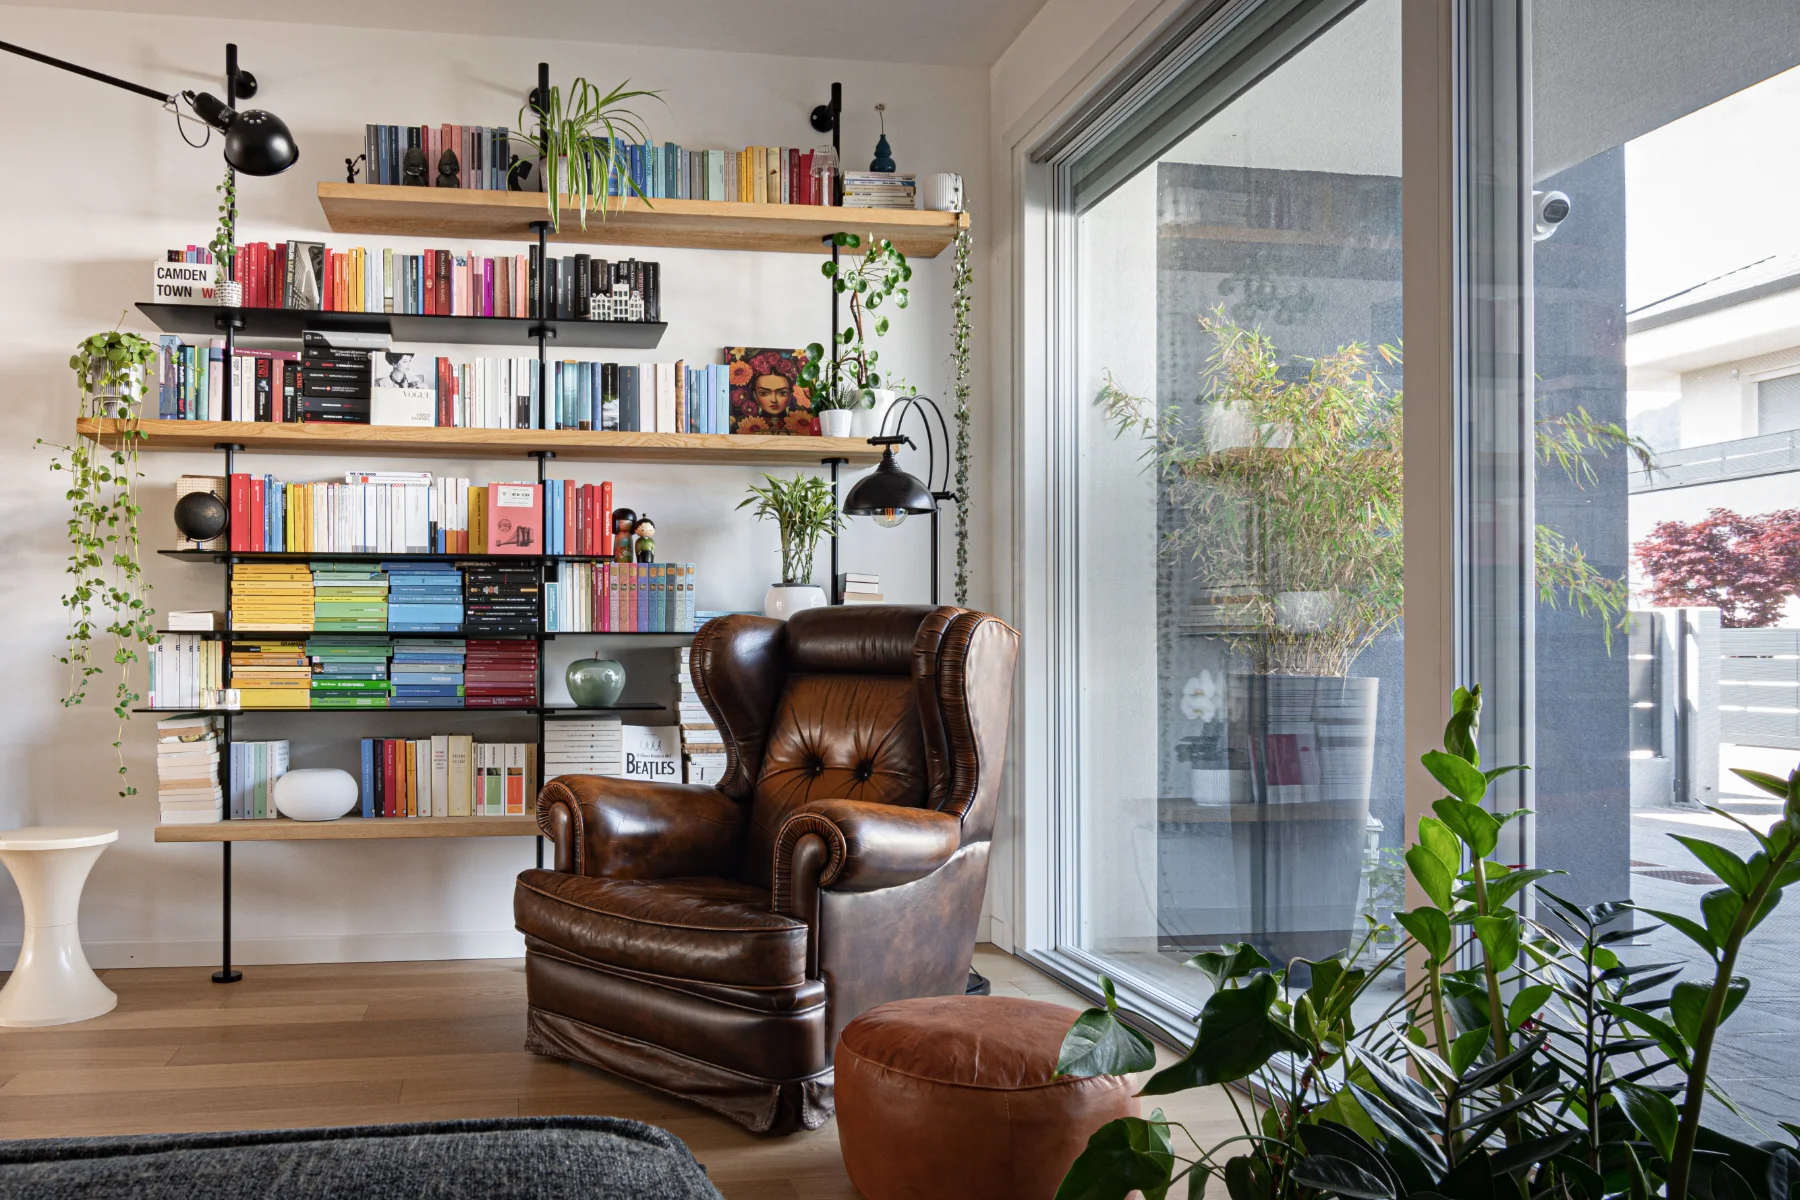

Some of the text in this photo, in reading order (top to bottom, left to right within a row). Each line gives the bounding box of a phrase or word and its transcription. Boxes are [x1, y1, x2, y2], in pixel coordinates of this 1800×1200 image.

[157, 267, 207, 282] CAMDEN
[156, 284, 192, 298] TOWN
[626, 753, 675, 779] BEATLES
